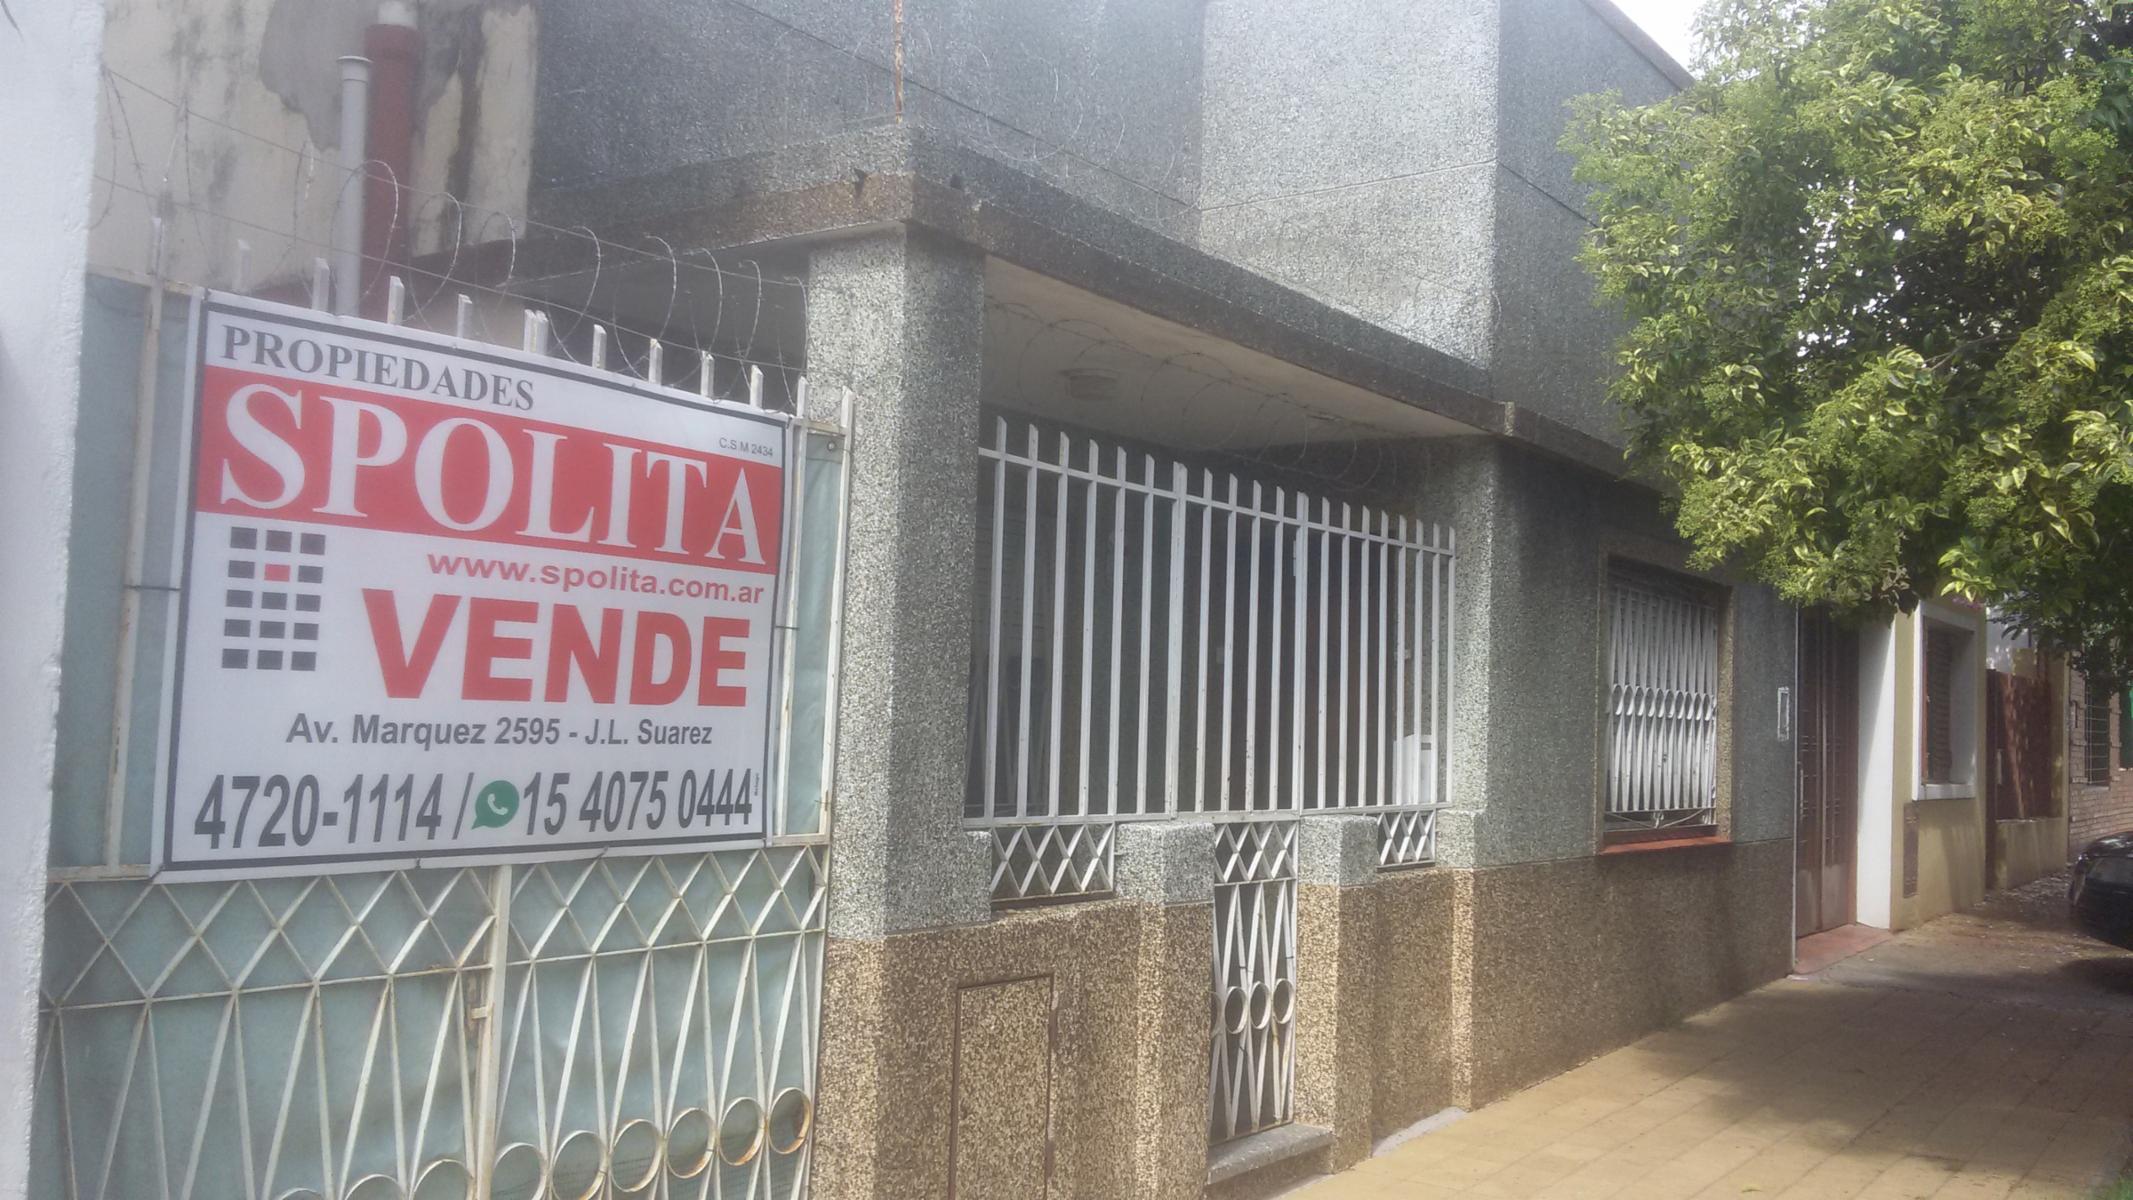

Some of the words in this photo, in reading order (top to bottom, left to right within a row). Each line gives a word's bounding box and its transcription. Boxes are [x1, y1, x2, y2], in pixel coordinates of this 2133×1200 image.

[222, 325, 534, 411] PROPIEDADES
[220, 384, 766, 565] SPOLITA
[751, 443, 773, 457] 2434
[428, 555, 764, 604] www.spolita.com.ar
[362, 589, 750, 707] VENDE
[286, 713, 338, 743] Av.
[352, 715, 486, 751] Marquez
[495, 718, 560, 745] 2595
[585, 719, 628, 745] J.L.
[638, 720, 713, 745] Suarez
[194, 774, 443, 849] 4720-1114
[523, 772, 571, 836] 15
[579, 771, 668, 832] 4075
[678, 769, 753, 828] 0444
